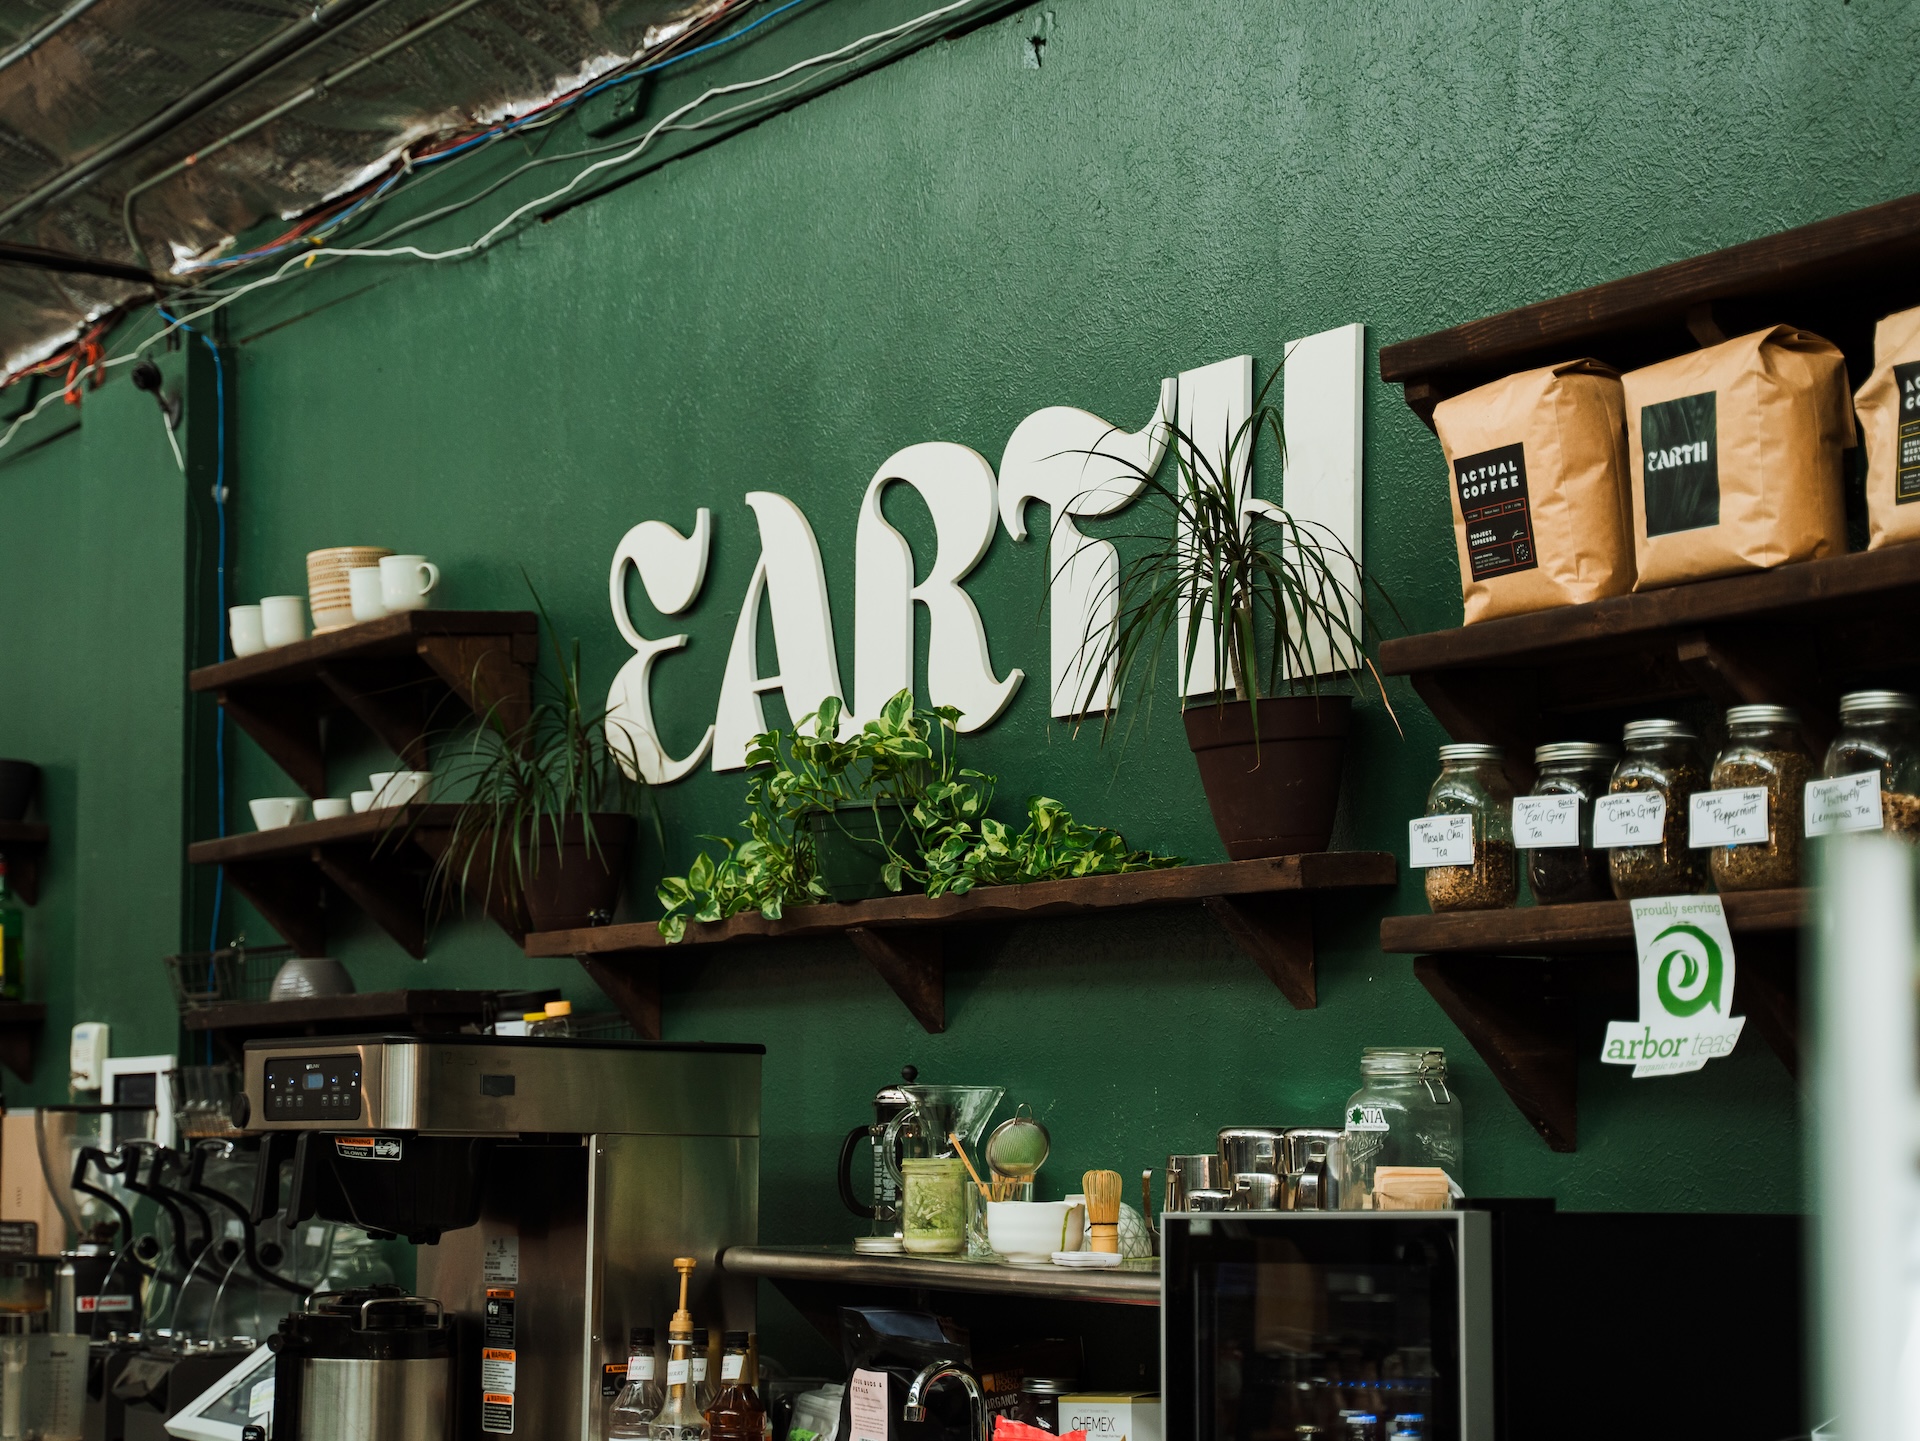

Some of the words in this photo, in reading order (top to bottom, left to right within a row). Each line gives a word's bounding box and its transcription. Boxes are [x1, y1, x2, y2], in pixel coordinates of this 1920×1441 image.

[1648, 441, 1708, 472] EARTH
[1461, 460, 1517, 485] ACTUAL
[1463, 475, 1519, 499] COFFEE
[1470, 529, 1493, 540] PROJECT
[1472, 535, 1497, 547] ESPRESSO
[605, 323, 1364, 786] EARTH
[1518, 802, 1542, 815] Organic
[1558, 798, 1576, 808] Black
[1600, 798, 1624, 811] Organic
[1696, 797, 1723, 812] Organic
[1855, 806, 1871, 816] Tea
[1525, 809, 1545, 825] Earl
[1546, 809, 1567, 824] Grey
[1609, 808, 1636, 822] Citrus
[1637, 804, 1662, 819] Ginger
[1713, 803, 1758, 825] Peppermint
[1423, 832, 1444, 843] Masala
[1446, 828, 1464, 841] Chai
[1529, 827, 1543, 838] Tea
[1621, 823, 1640, 835] Tea
[1726, 824, 1747, 838] Tea
[1432, 847, 1448, 858] Tea
[1635, 901, 1679, 919] proudly
[1681, 901, 1721, 916] serving
[1607, 1026, 1689, 1060] arbor
[1692, 1032, 1737, 1056] teas
[1637, 1060, 1667, 1074] organic
[1347, 1106, 1384, 1124] SNIA
[491, 1351, 512, 1360] WARNING
[491, 1395, 510, 1403] WARNING
[986, 1393, 1019, 1410] ORGANIC
[1071, 1416, 1115, 1432] CHEMEX
